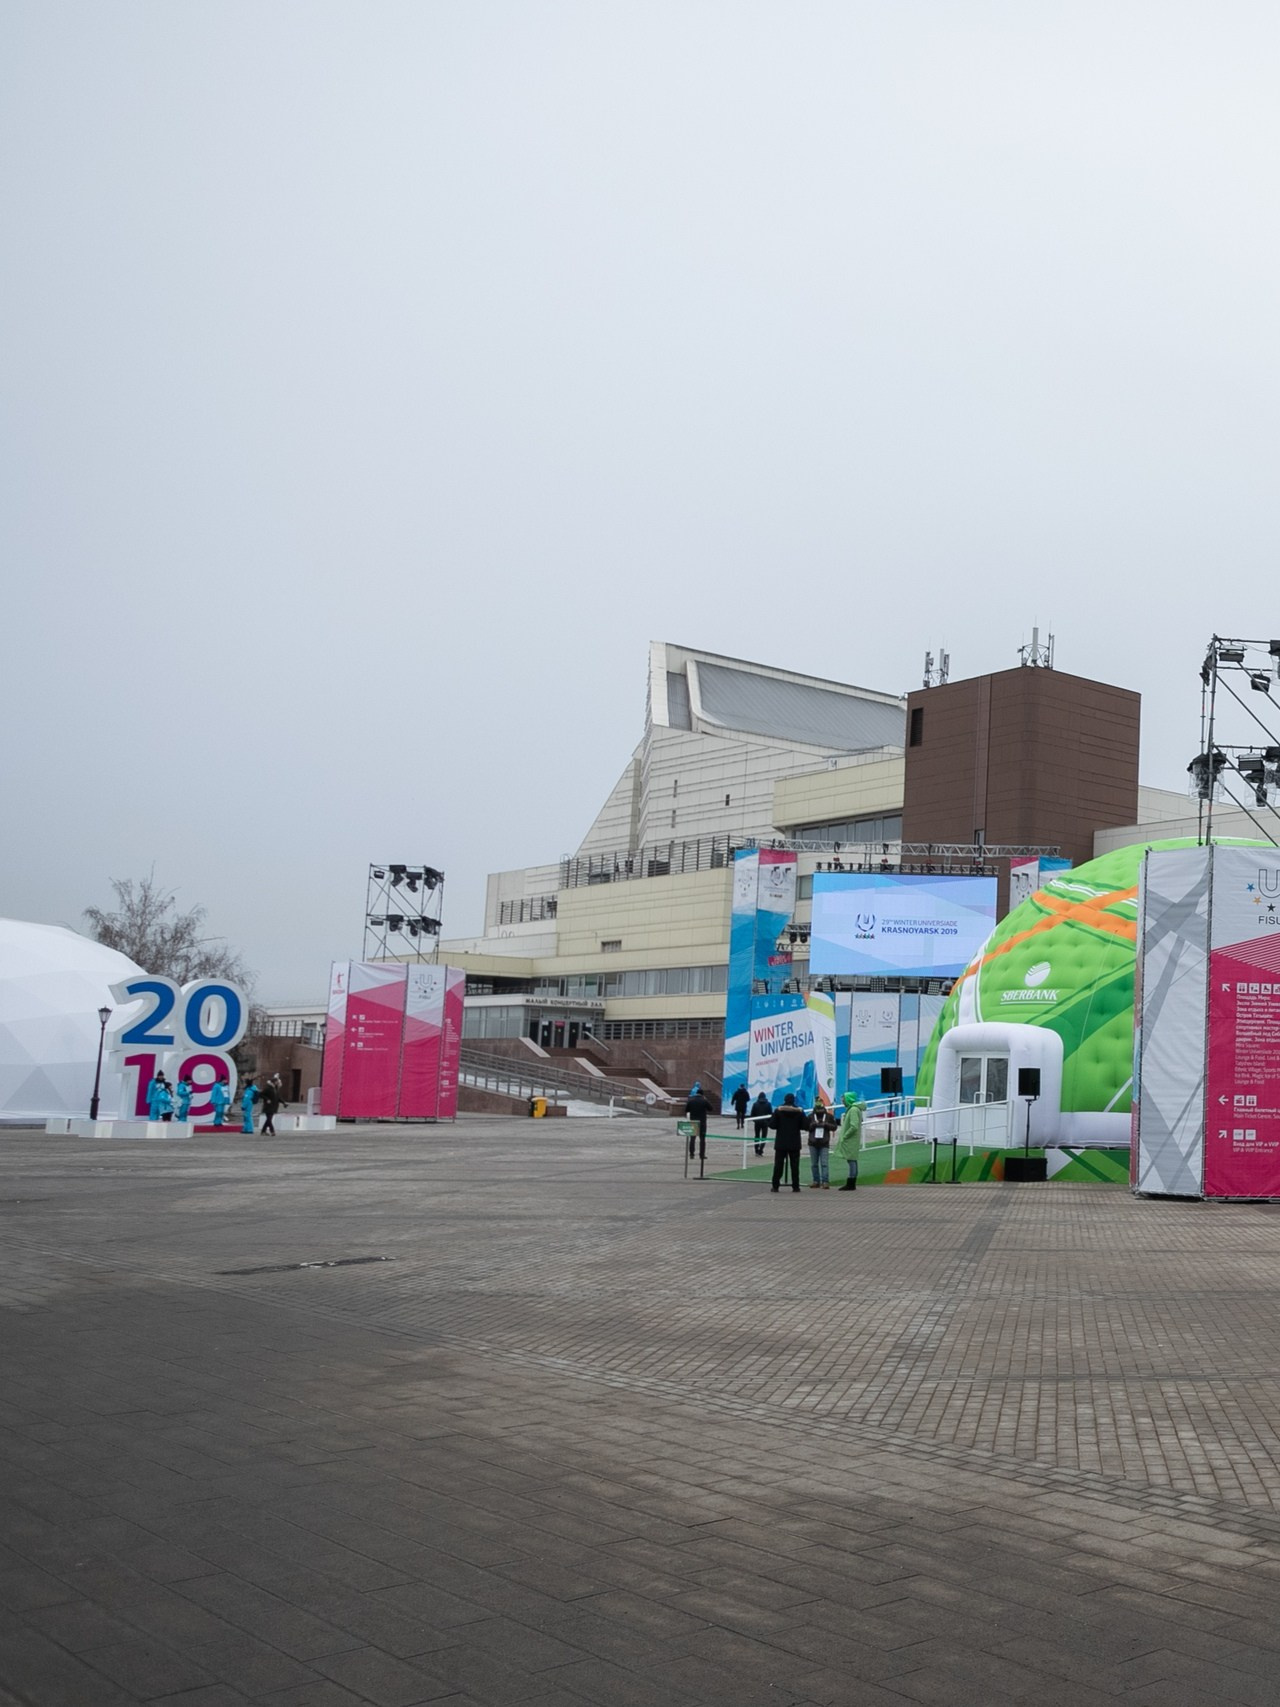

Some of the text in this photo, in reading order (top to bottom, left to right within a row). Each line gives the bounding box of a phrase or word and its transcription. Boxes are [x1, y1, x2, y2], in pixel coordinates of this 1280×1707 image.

[1001, 988, 1059, 1001] SBERBANK
[120, 980, 242, 1047] 20
[754, 1020, 794, 1043] WINTER
[761, 1030, 815, 1057] UNIVERSIA
[124, 1053, 230, 1116] 19
